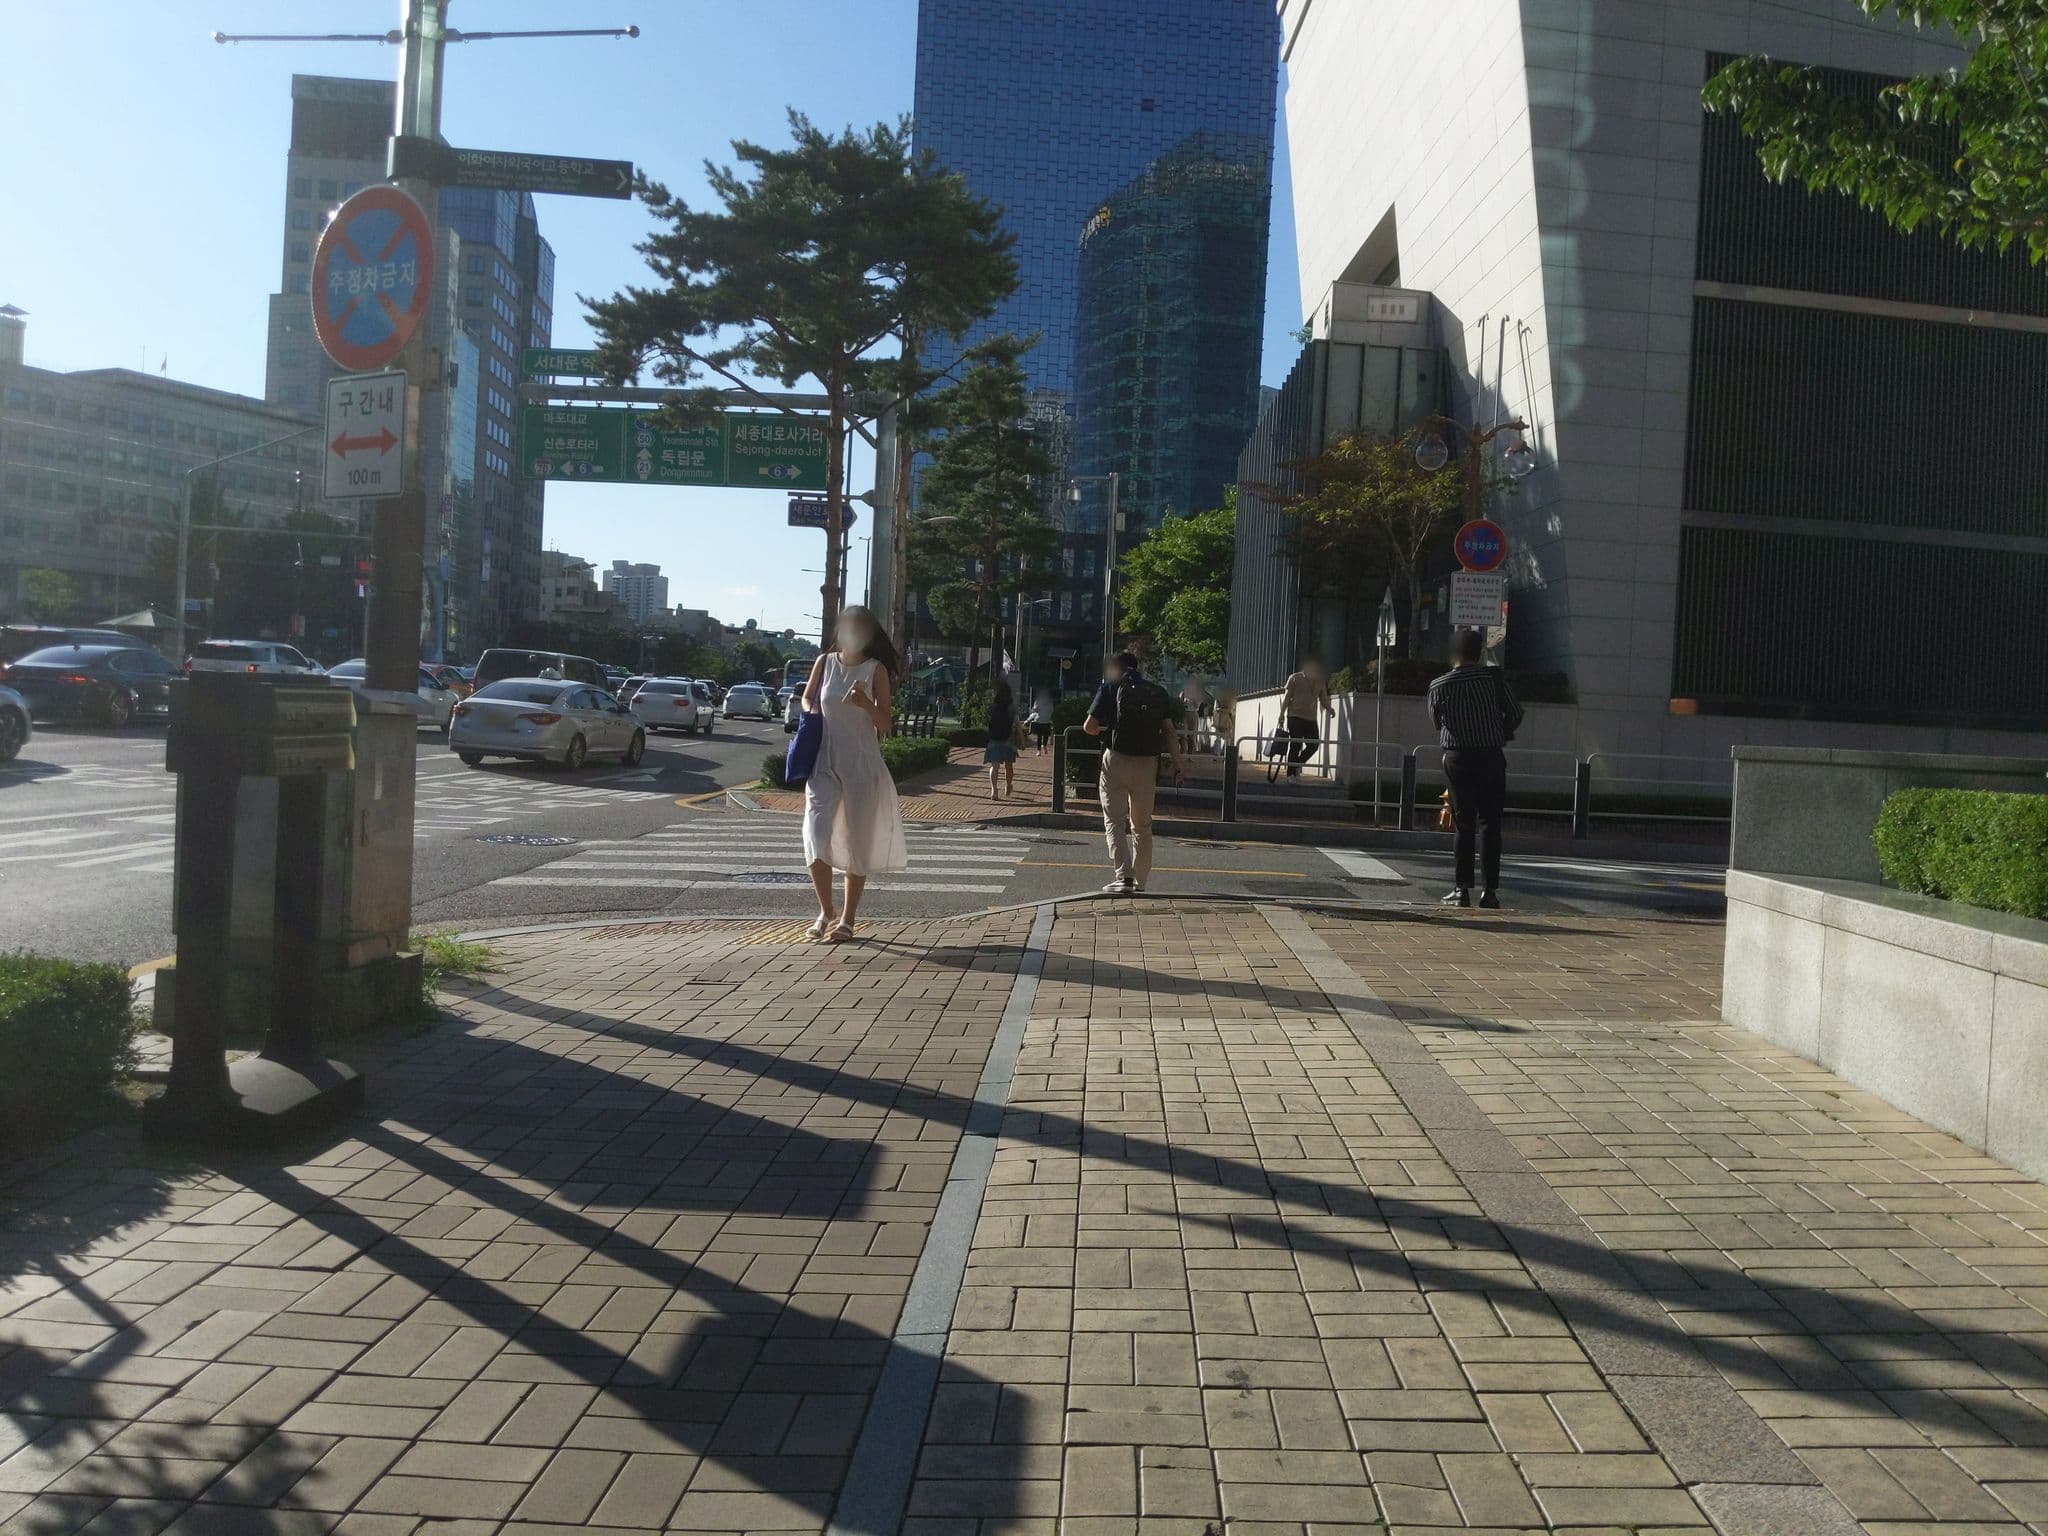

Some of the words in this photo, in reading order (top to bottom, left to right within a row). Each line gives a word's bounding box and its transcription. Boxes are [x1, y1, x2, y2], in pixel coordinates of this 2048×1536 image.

[458, 153, 595, 176] 이화여자외국어고등학교
[328, 259, 415, 296] 주정차금지
[338, 386, 393, 417] 구간내
[543, 412, 587, 425] 마포대교
[639, 434, 650, 444] 50
[735, 424, 823, 444] 세종대로사거리
[543, 438, 599, 451] 신촌로터리
[735, 443, 804, 457] Sejong-daero
[661, 449, 705, 467] 독립문
[639, 462, 650, 471] 21
[774, 466, 782, 477] 6
